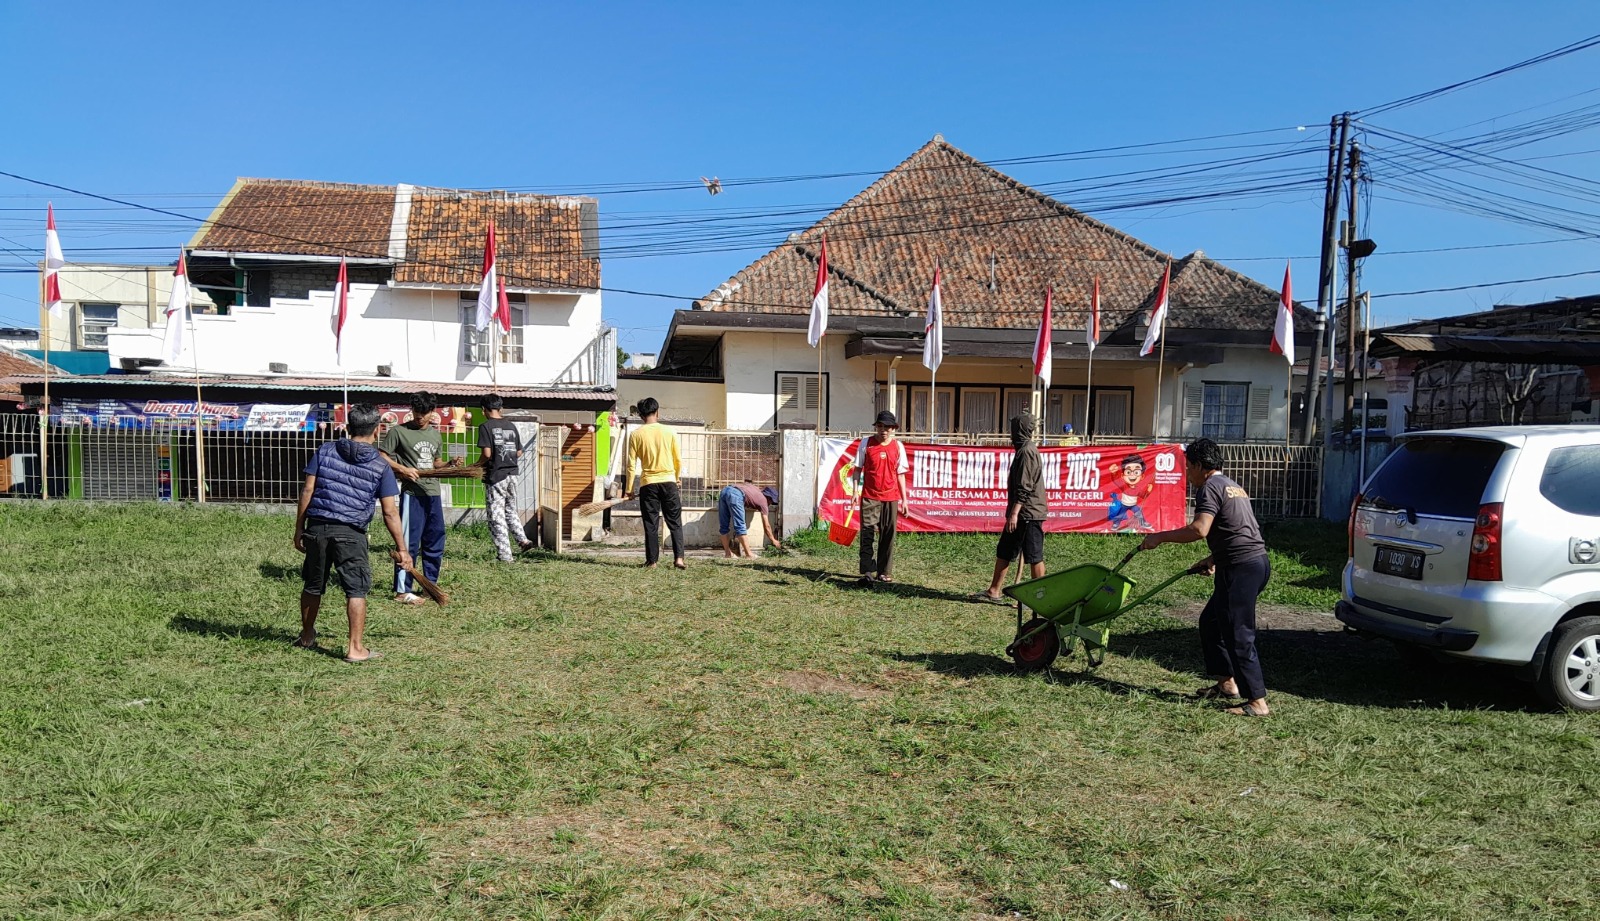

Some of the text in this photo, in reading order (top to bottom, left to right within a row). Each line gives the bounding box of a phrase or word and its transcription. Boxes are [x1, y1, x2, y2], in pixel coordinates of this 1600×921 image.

[914, 450, 952, 488] KERJA
[957, 451, 994, 488] BAKTI
[1066, 453, 1100, 490] 2025
[1155, 453, 1175, 472] 80
[909, 490, 939, 500] KERJA
[943, 490, 990, 499] BERSAMA
[1064, 491, 1104, 499] NEGERI
[1378, 550, 1421, 568] D 1030 XS
